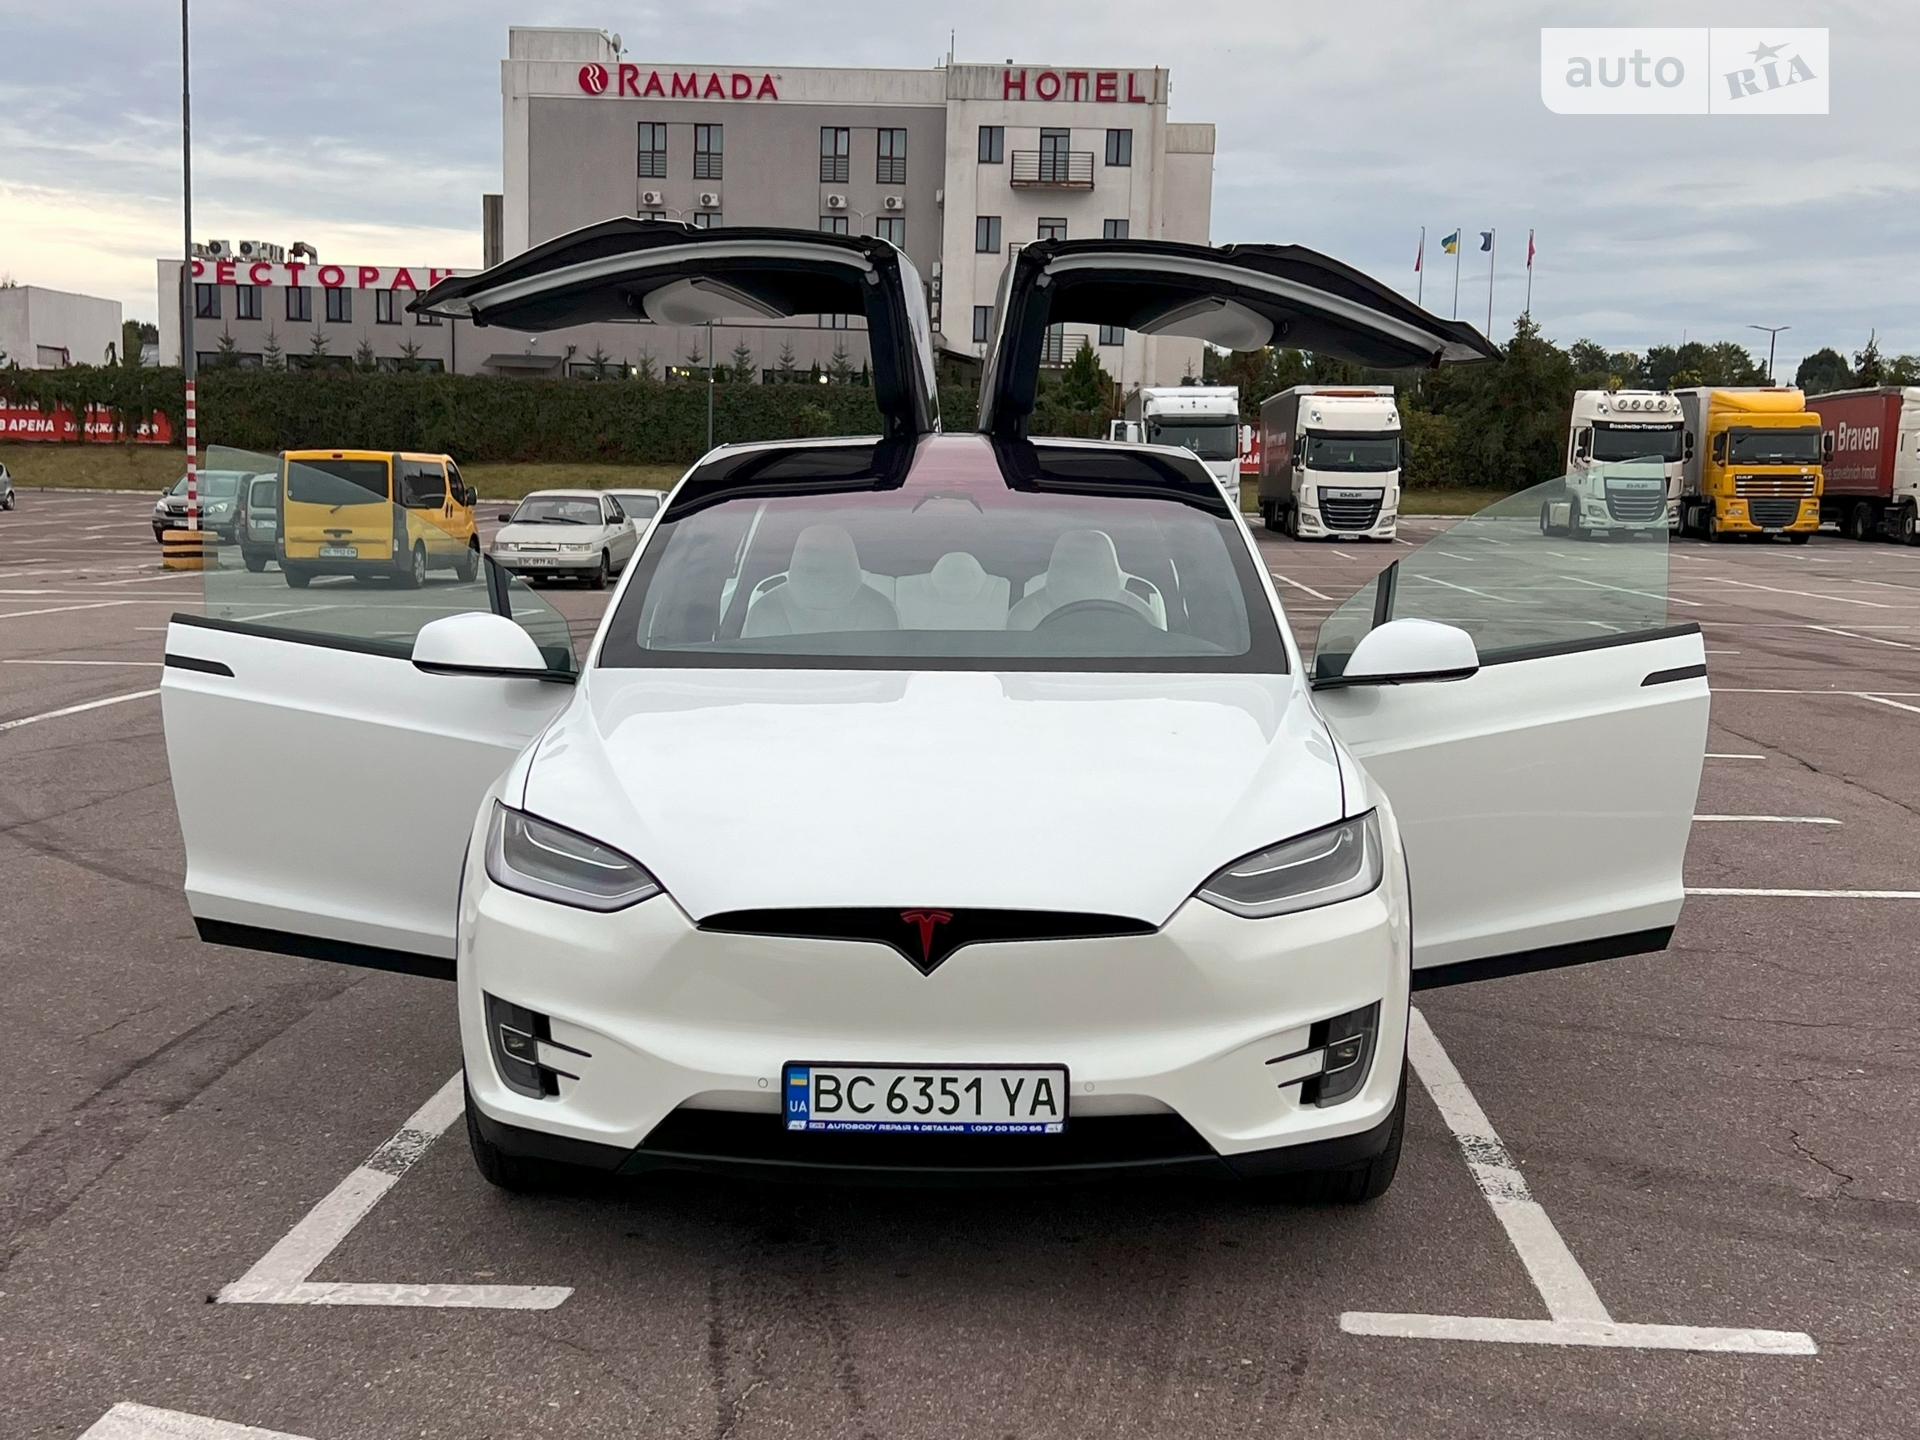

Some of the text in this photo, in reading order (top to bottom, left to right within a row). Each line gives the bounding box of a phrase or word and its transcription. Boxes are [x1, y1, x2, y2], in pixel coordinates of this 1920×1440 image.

[618, 63, 779, 100] RAMADA
[1003, 70, 1146, 103] HOTEL
[9, 419, 55, 432] АРЕНА
[1838, 421, 1879, 452] Braven
[789, 1099, 808, 1112] UA
[814, 1074, 1058, 1117] BC 6351 YA
[921, 1124, 964, 1132] DETAILING
